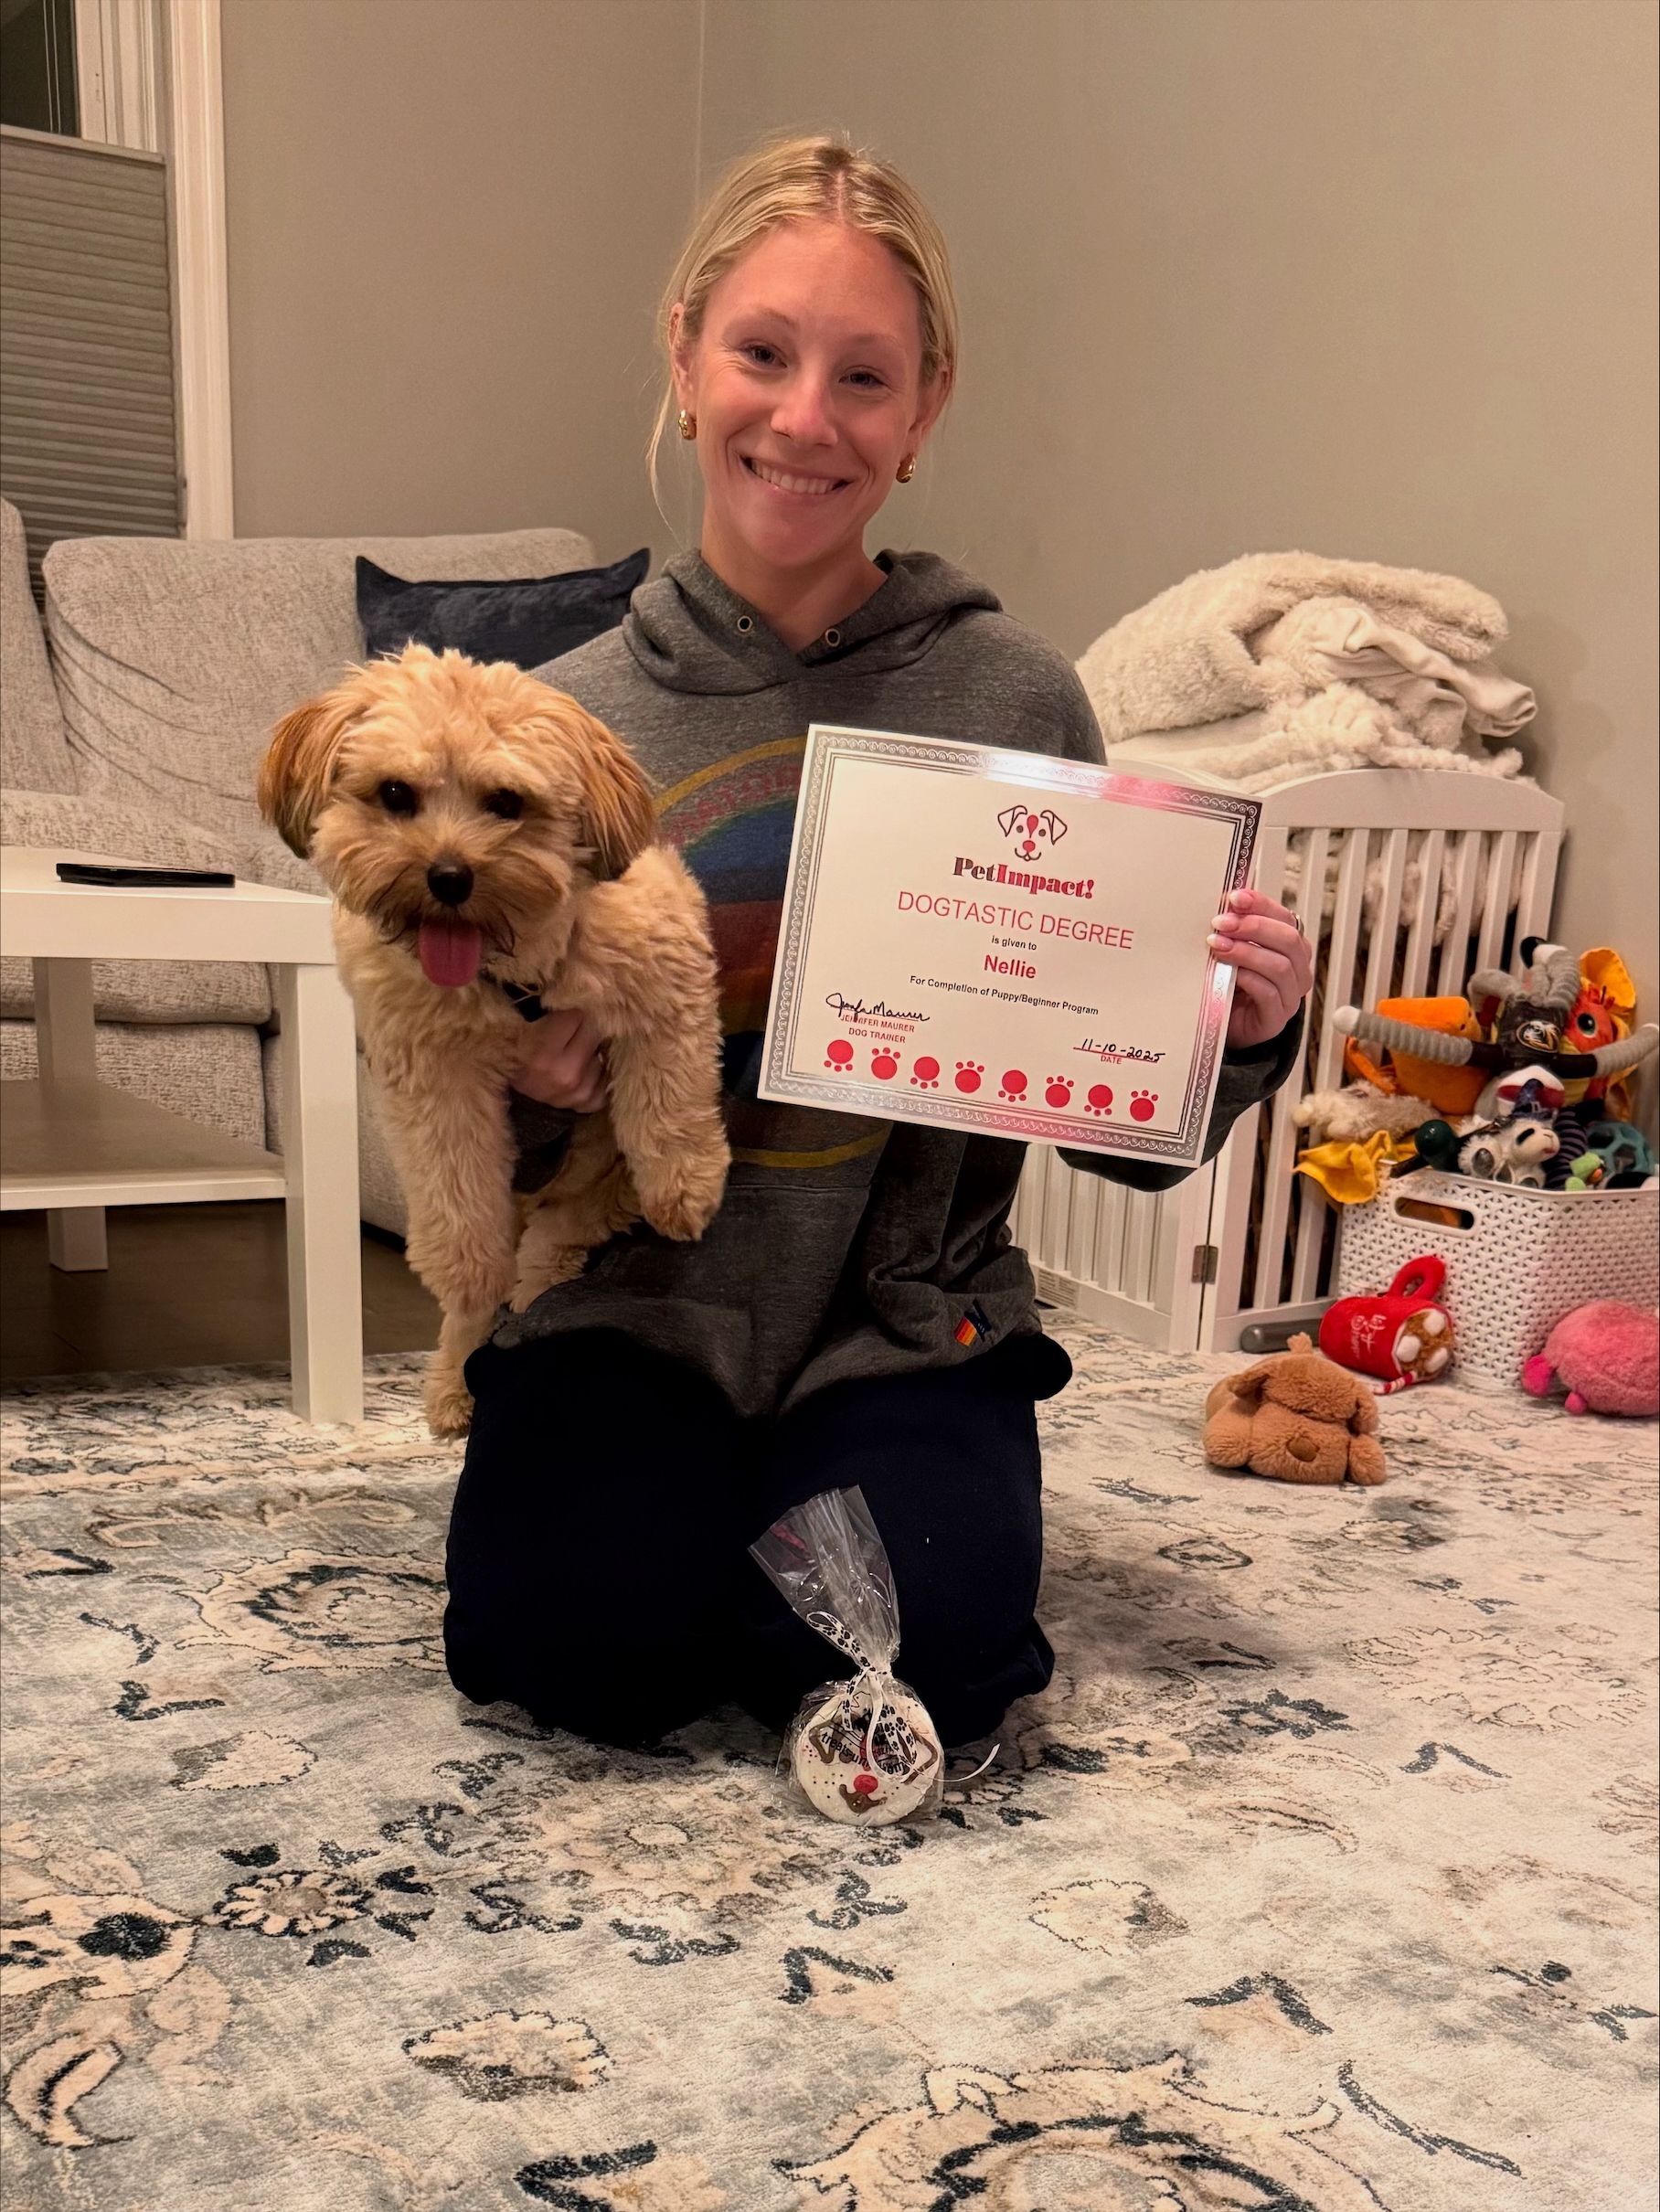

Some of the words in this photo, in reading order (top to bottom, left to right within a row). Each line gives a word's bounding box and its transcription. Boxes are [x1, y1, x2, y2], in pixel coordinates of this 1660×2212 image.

[952, 856, 1095, 899] PetImpact!
[898, 890, 1034, 931] DOGTASTIC
[1039, 914, 1134, 950] DEGREE
[991, 935, 1000, 945] is
[1002, 937, 1027, 950] given
[1028, 941, 1038, 951] to
[984, 954, 1037, 979] Nellie
[910, 975, 926, 985] For
[927, 978, 978, 994] Completion
[980, 987, 991, 996] of
[991, 989, 1060, 1008] Puppy/Beginner
[1062, 1001, 1099, 1016] Program
[848, 1027, 867, 1037] DOG
[870, 1031, 906, 1043] TRAINER
[880, 1020, 915, 1033] MAURER
[1101, 1055, 1123, 1065] DATE
